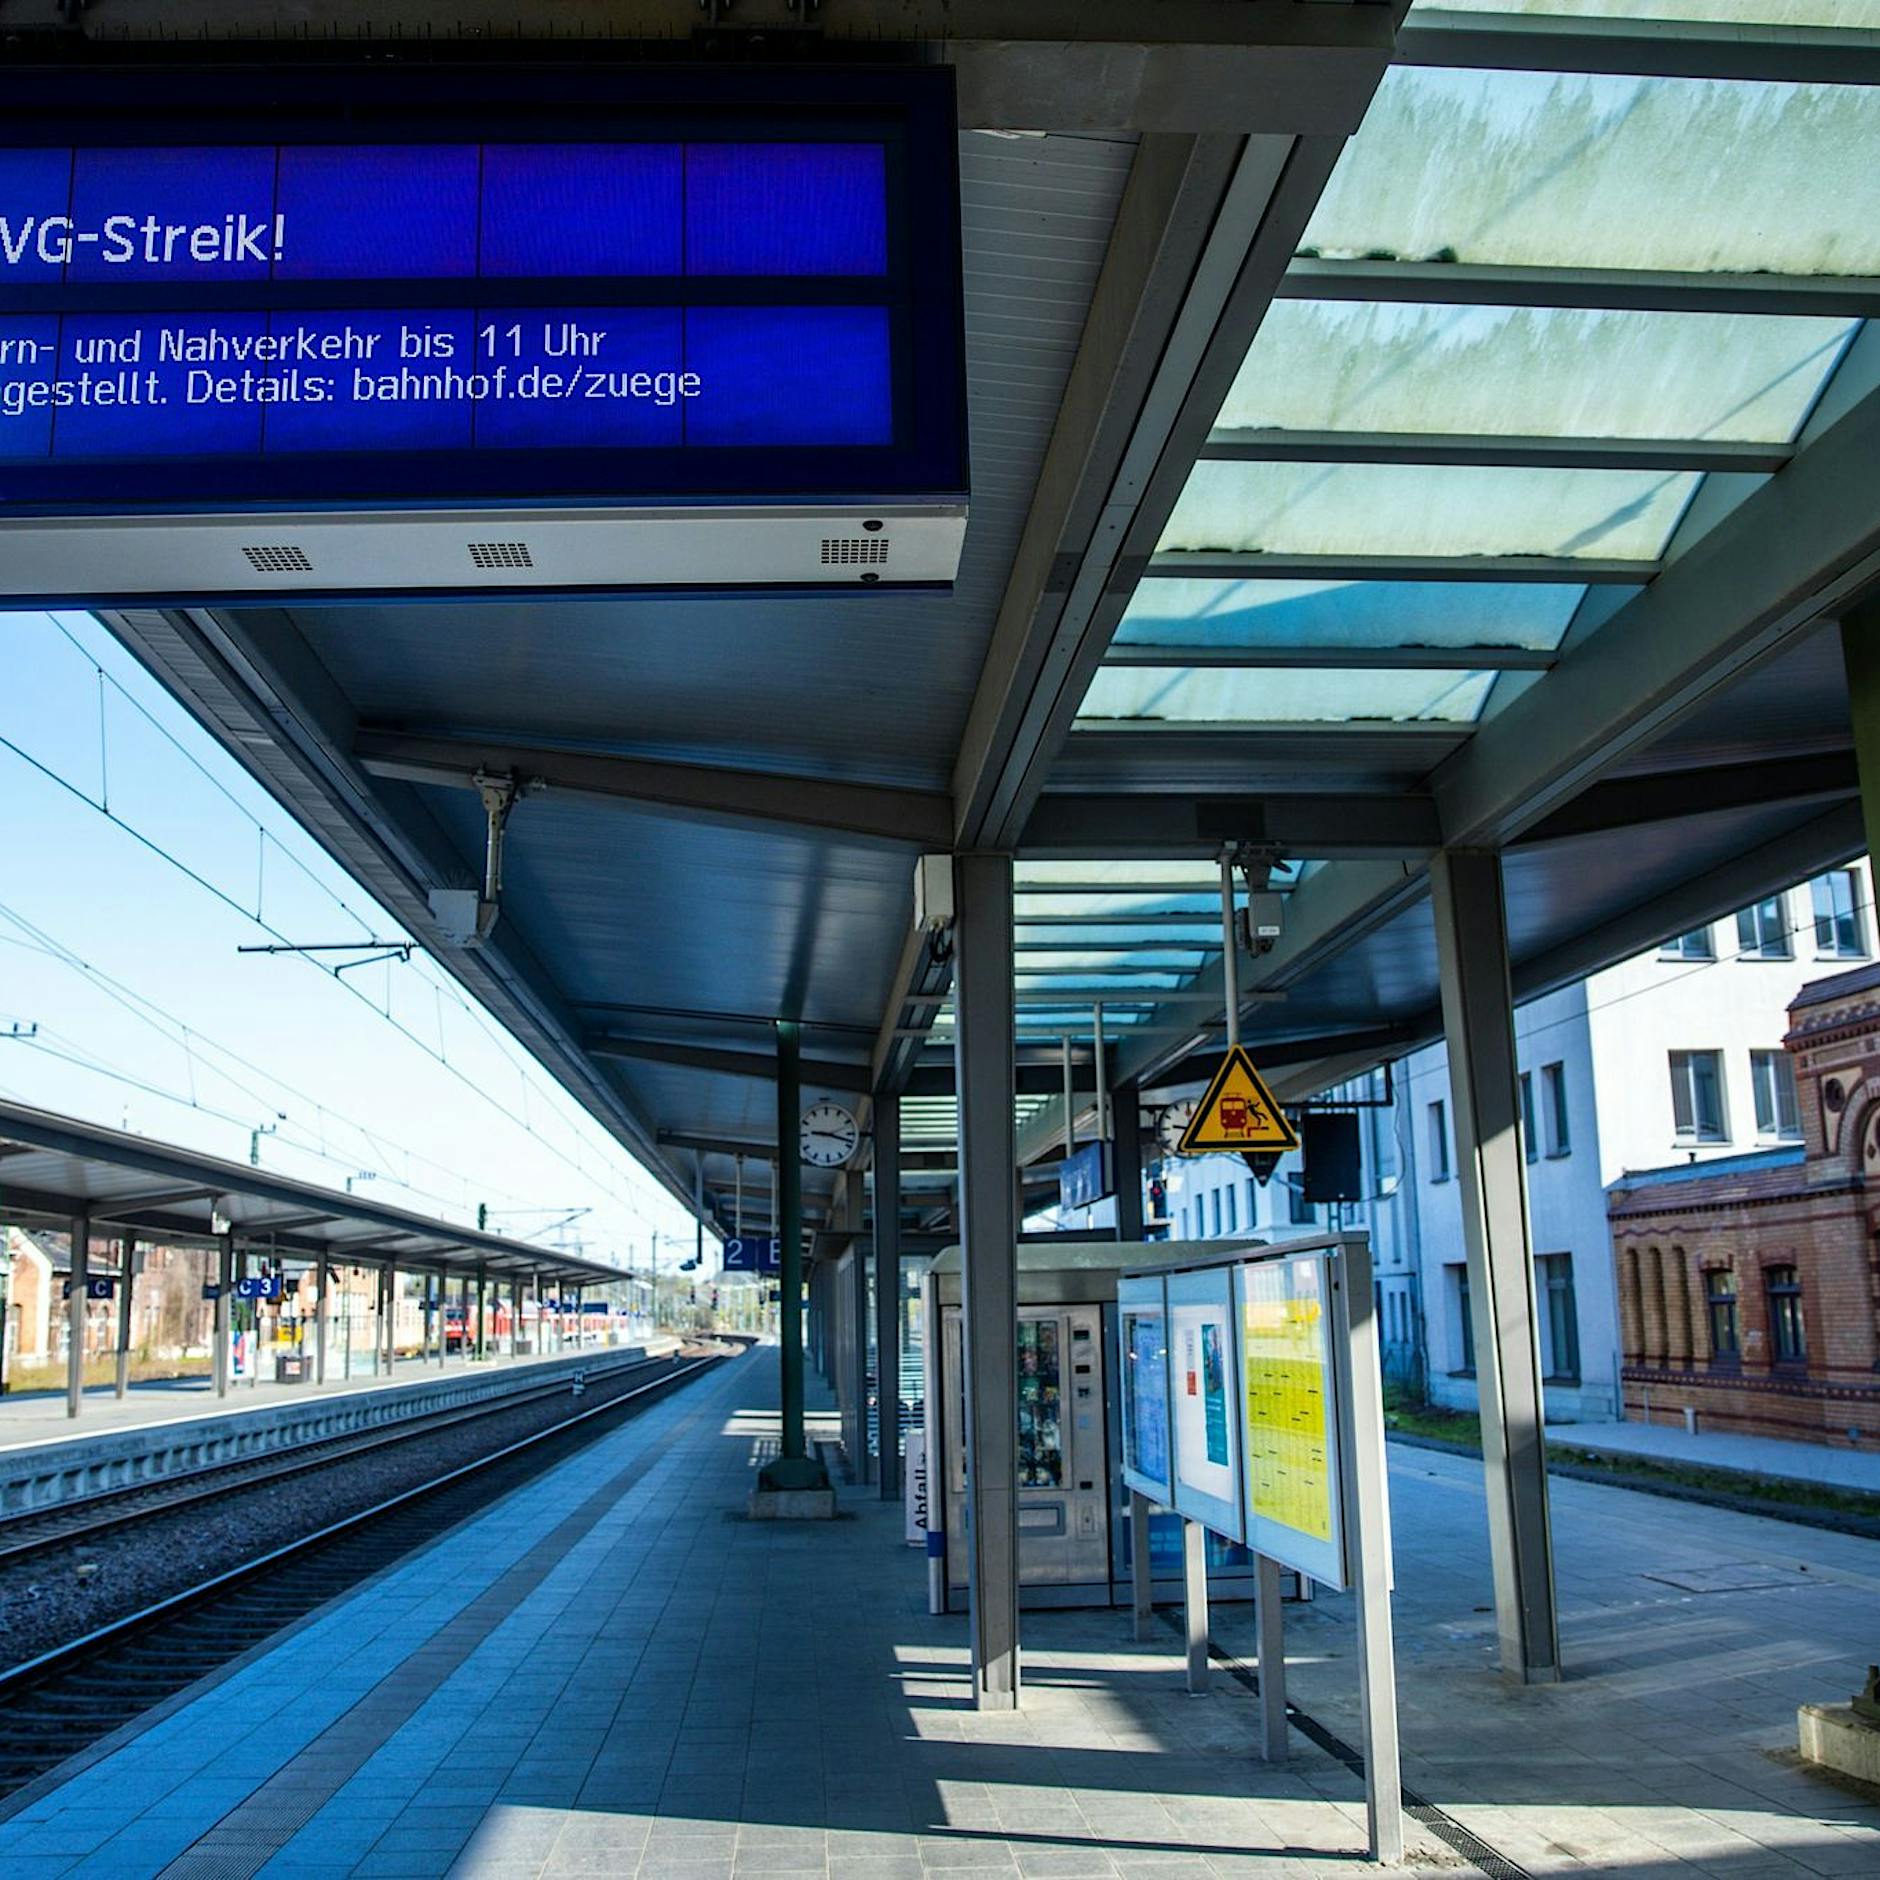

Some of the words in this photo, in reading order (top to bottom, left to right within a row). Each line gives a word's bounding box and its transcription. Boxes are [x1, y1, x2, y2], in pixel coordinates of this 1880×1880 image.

[75, 329, 142, 363] und
[159, 326, 381, 362] Nahverkehr
[400, 325, 454, 358] bis
[480, 324, 521, 357] 11
[544, 323, 607, 357] Uhr
[2, 371, 167, 416] gestellt.
[187, 368, 334, 404] Details:
[353, 364, 701, 406] bahnhof.de/zuege
[727, 1239, 744, 1265] 2
[94, 1280, 108, 1296] C
[238, 1279, 252, 1295] C
[260, 1279, 273, 1295] 3
[914, 1469, 927, 1529] Abfall
